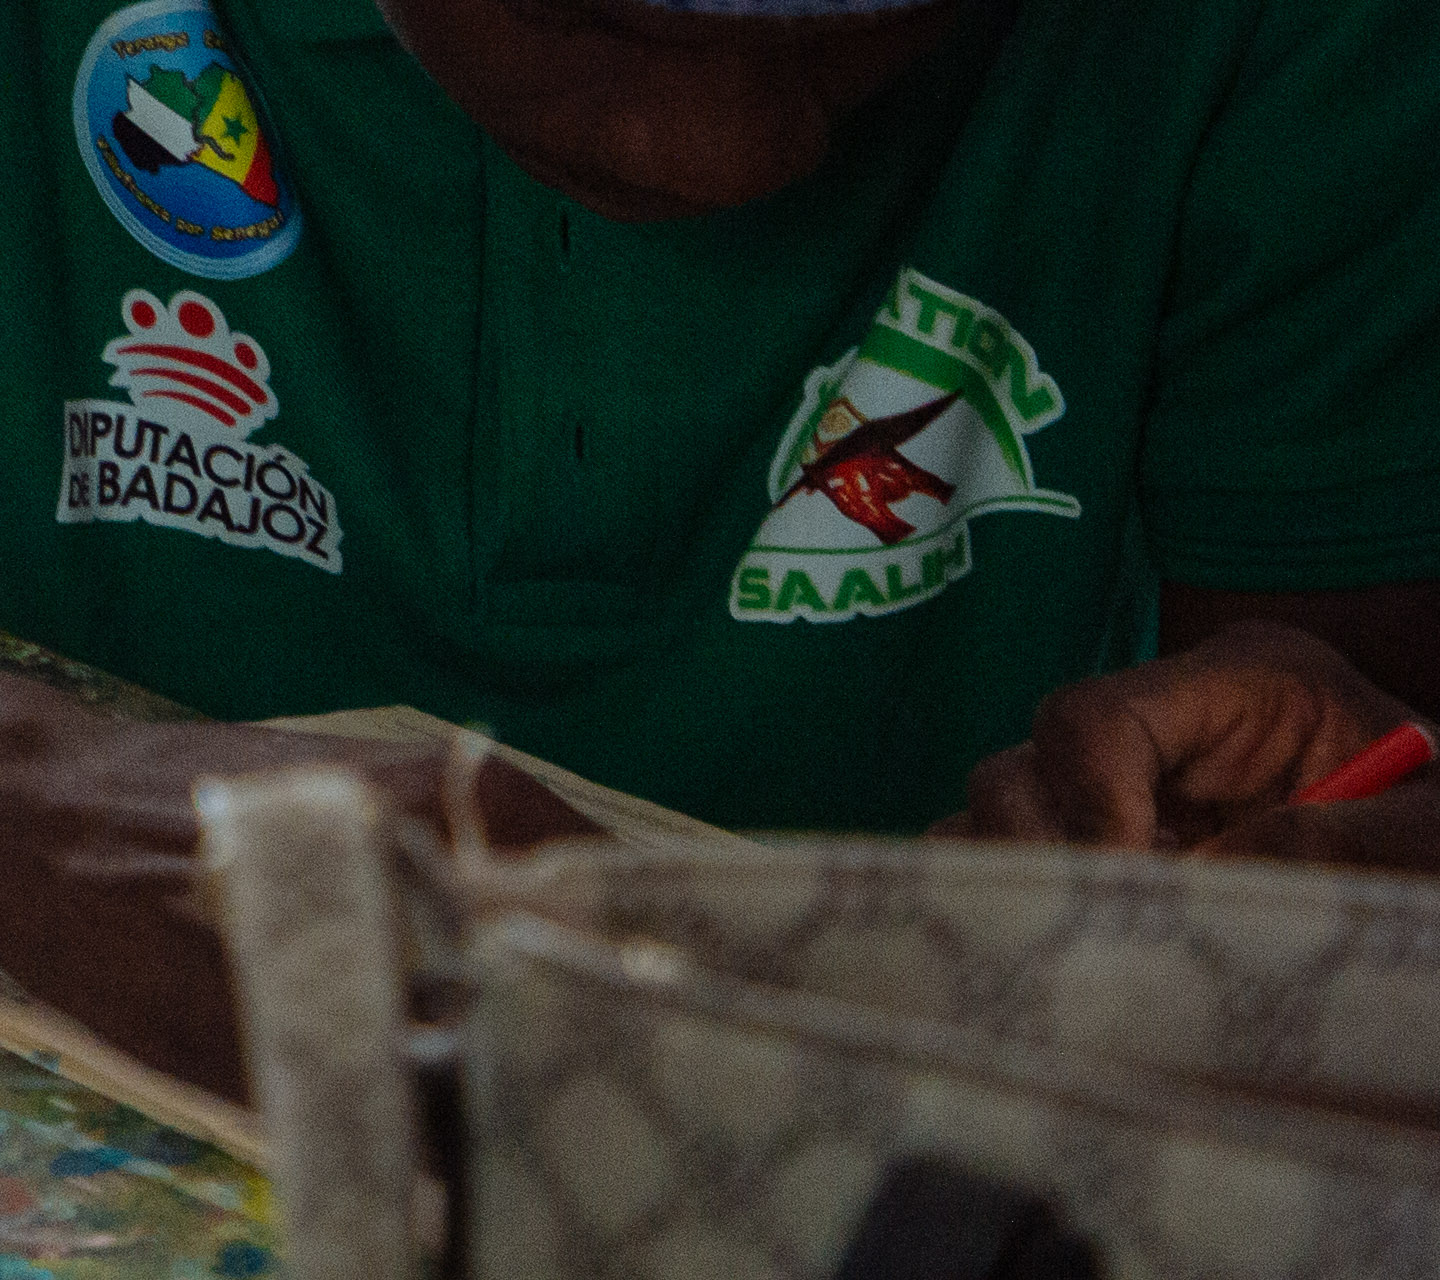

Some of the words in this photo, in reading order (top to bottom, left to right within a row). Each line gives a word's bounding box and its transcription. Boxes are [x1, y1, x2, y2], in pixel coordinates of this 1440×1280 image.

[68, 412, 328, 524] DIPUTACIÓN
[68, 473, 90, 508] DE
[98, 461, 330, 560] BADAJOZ
